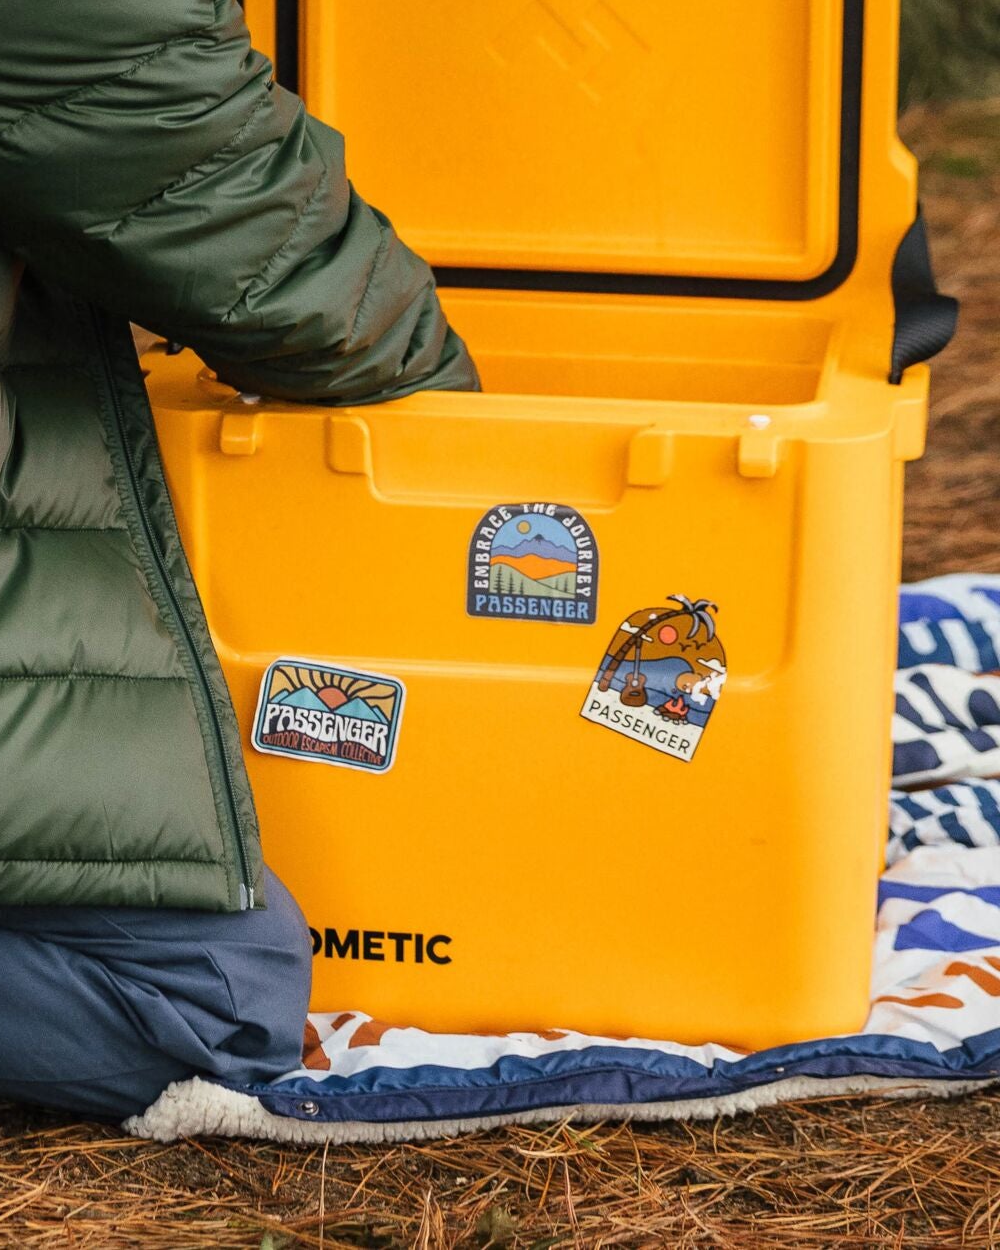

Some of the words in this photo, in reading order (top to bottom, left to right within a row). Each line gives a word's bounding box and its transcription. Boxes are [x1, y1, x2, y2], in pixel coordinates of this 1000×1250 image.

[474, 505, 513, 589] EMBRACE
[520, 503, 558, 517] THE
[562, 515, 593, 597] JOURNEY
[475, 594, 589, 620] PASSENGER
[262, 703, 389, 757] PASSENGER
[262, 731, 299, 750] OUTDOOR
[301, 735, 338, 756] ESCAPISM
[341, 741, 383, 766] COLLECTIVE
[588, 699, 691, 755] PASSENGER
